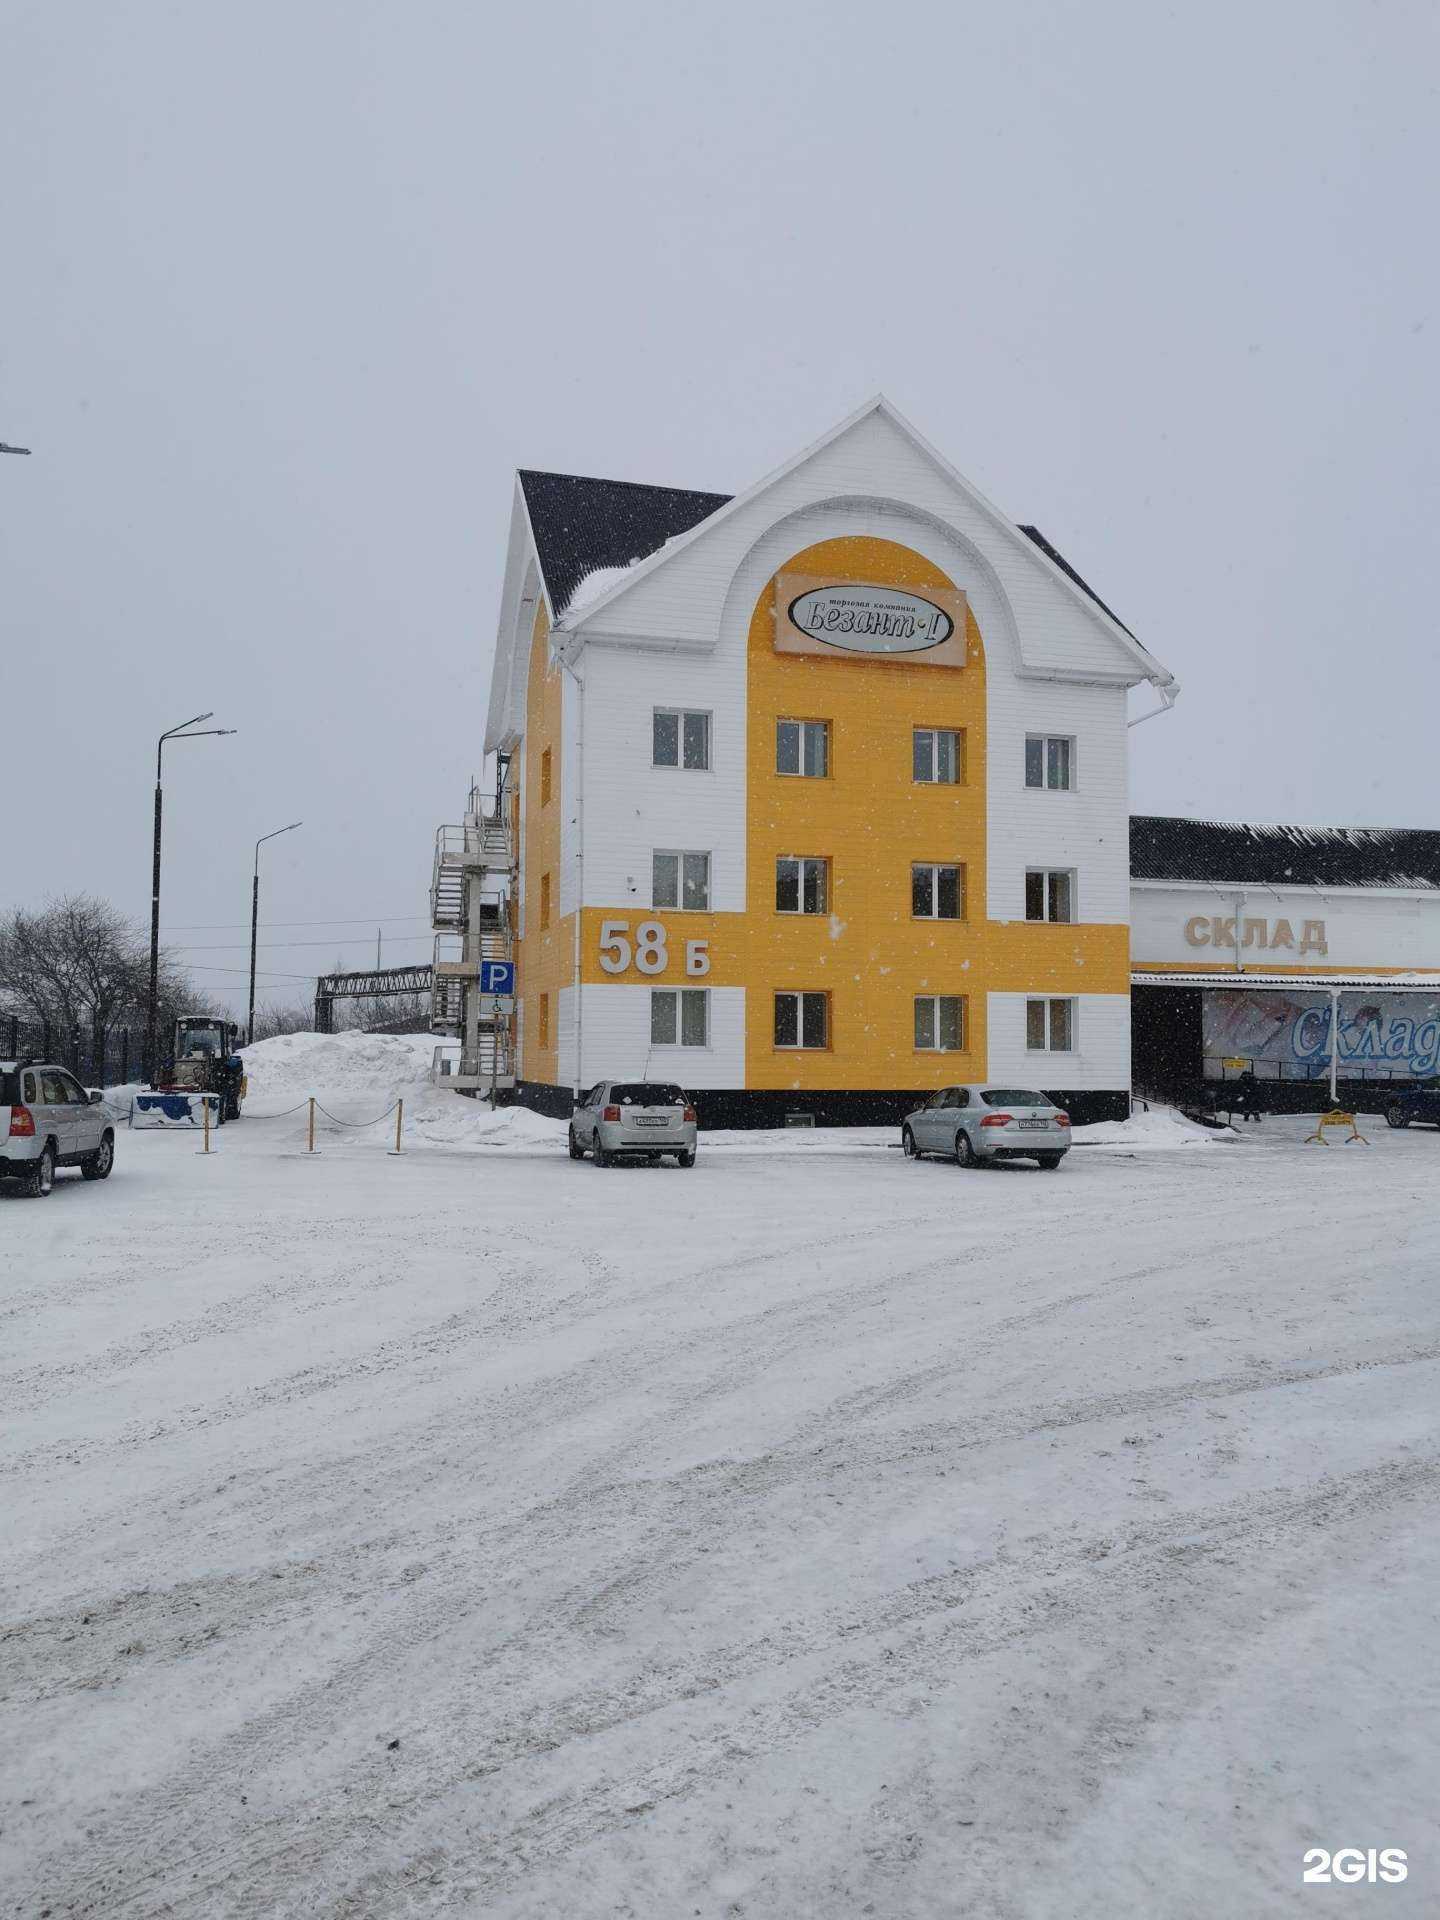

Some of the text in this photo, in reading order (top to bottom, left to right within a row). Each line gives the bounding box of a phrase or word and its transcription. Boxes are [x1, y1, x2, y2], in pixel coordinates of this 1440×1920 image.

[599, 920, 711, 976] 58 Б
[1184, 917, 1328, 955] СКЛАД
[489, 964, 508, 990] P
